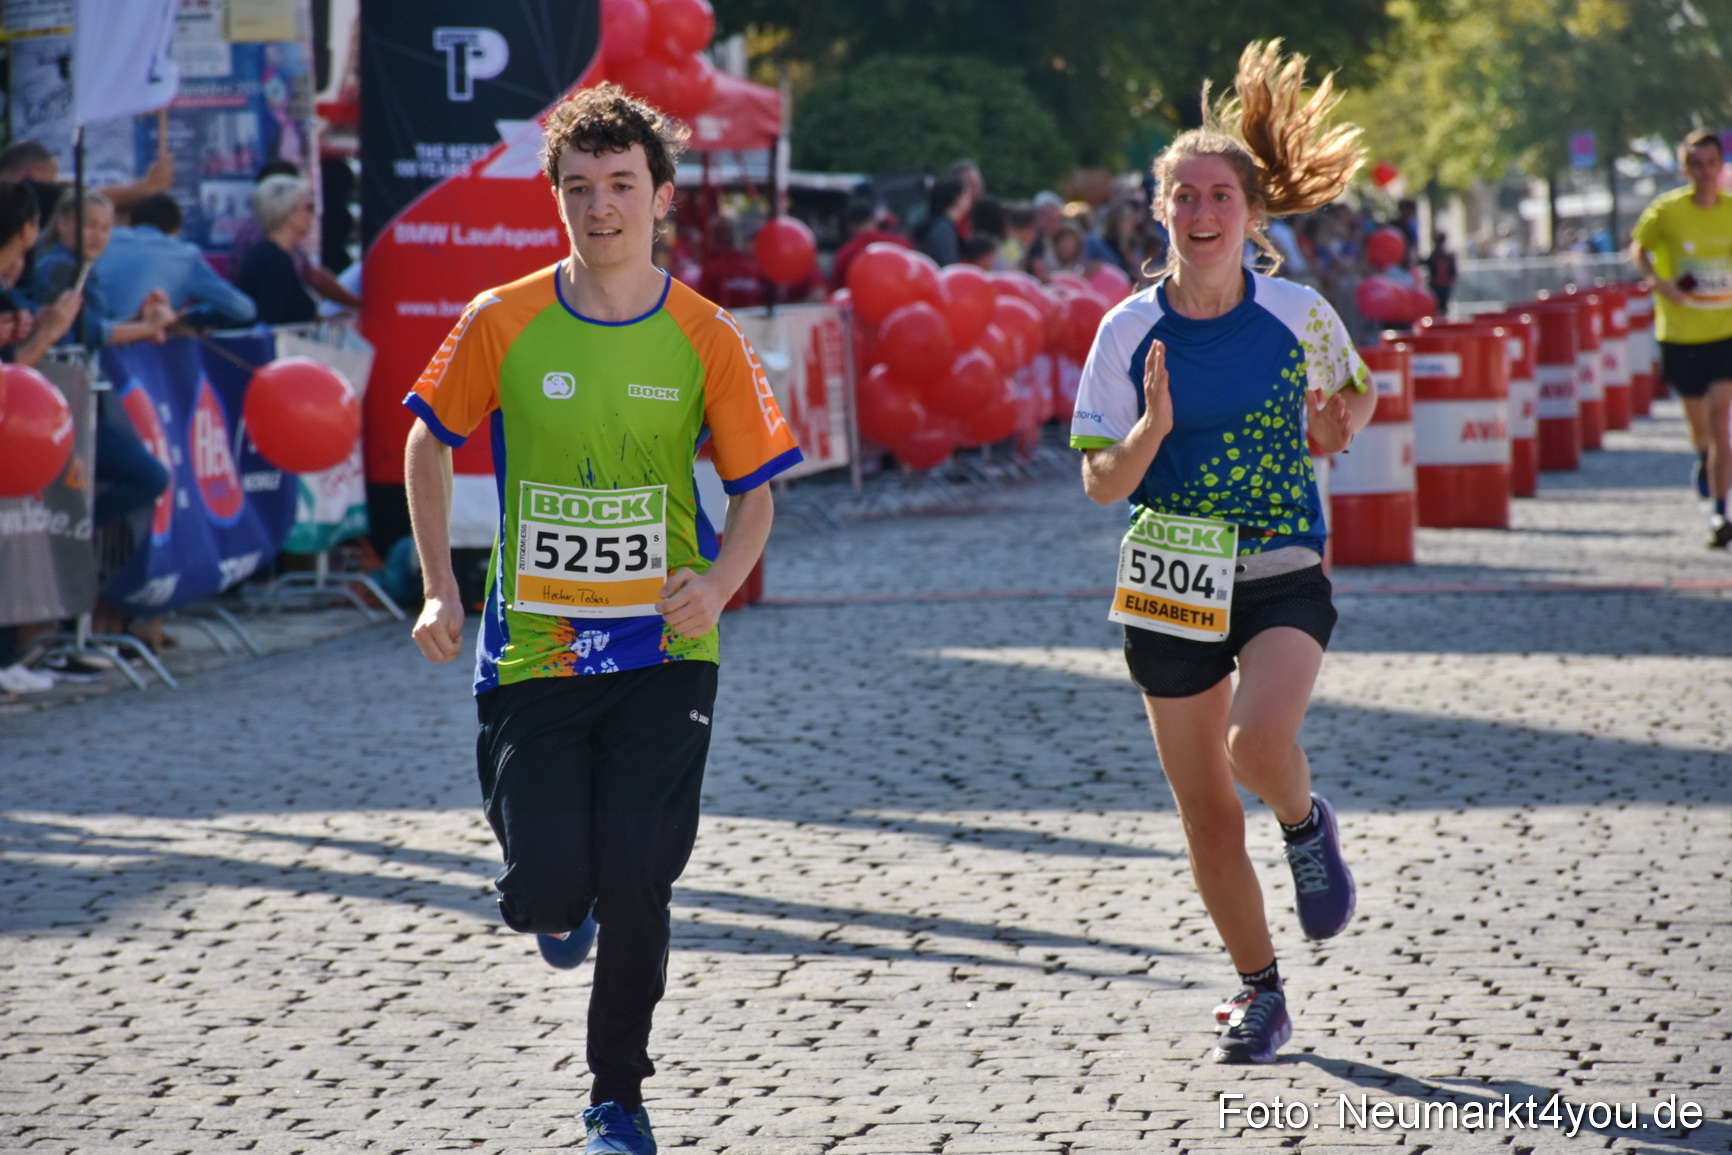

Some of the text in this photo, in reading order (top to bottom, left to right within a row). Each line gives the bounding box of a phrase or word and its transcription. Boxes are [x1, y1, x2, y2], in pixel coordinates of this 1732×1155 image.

[393, 222, 557, 249] BMW Laufsport
[628, 384, 680, 401] BOCK
[531, 489, 654, 524] BOCK
[534, 531, 648, 574] 5253
[1129, 549, 1215, 599] 5204
[1125, 594, 1215, 627] ELISABETH
